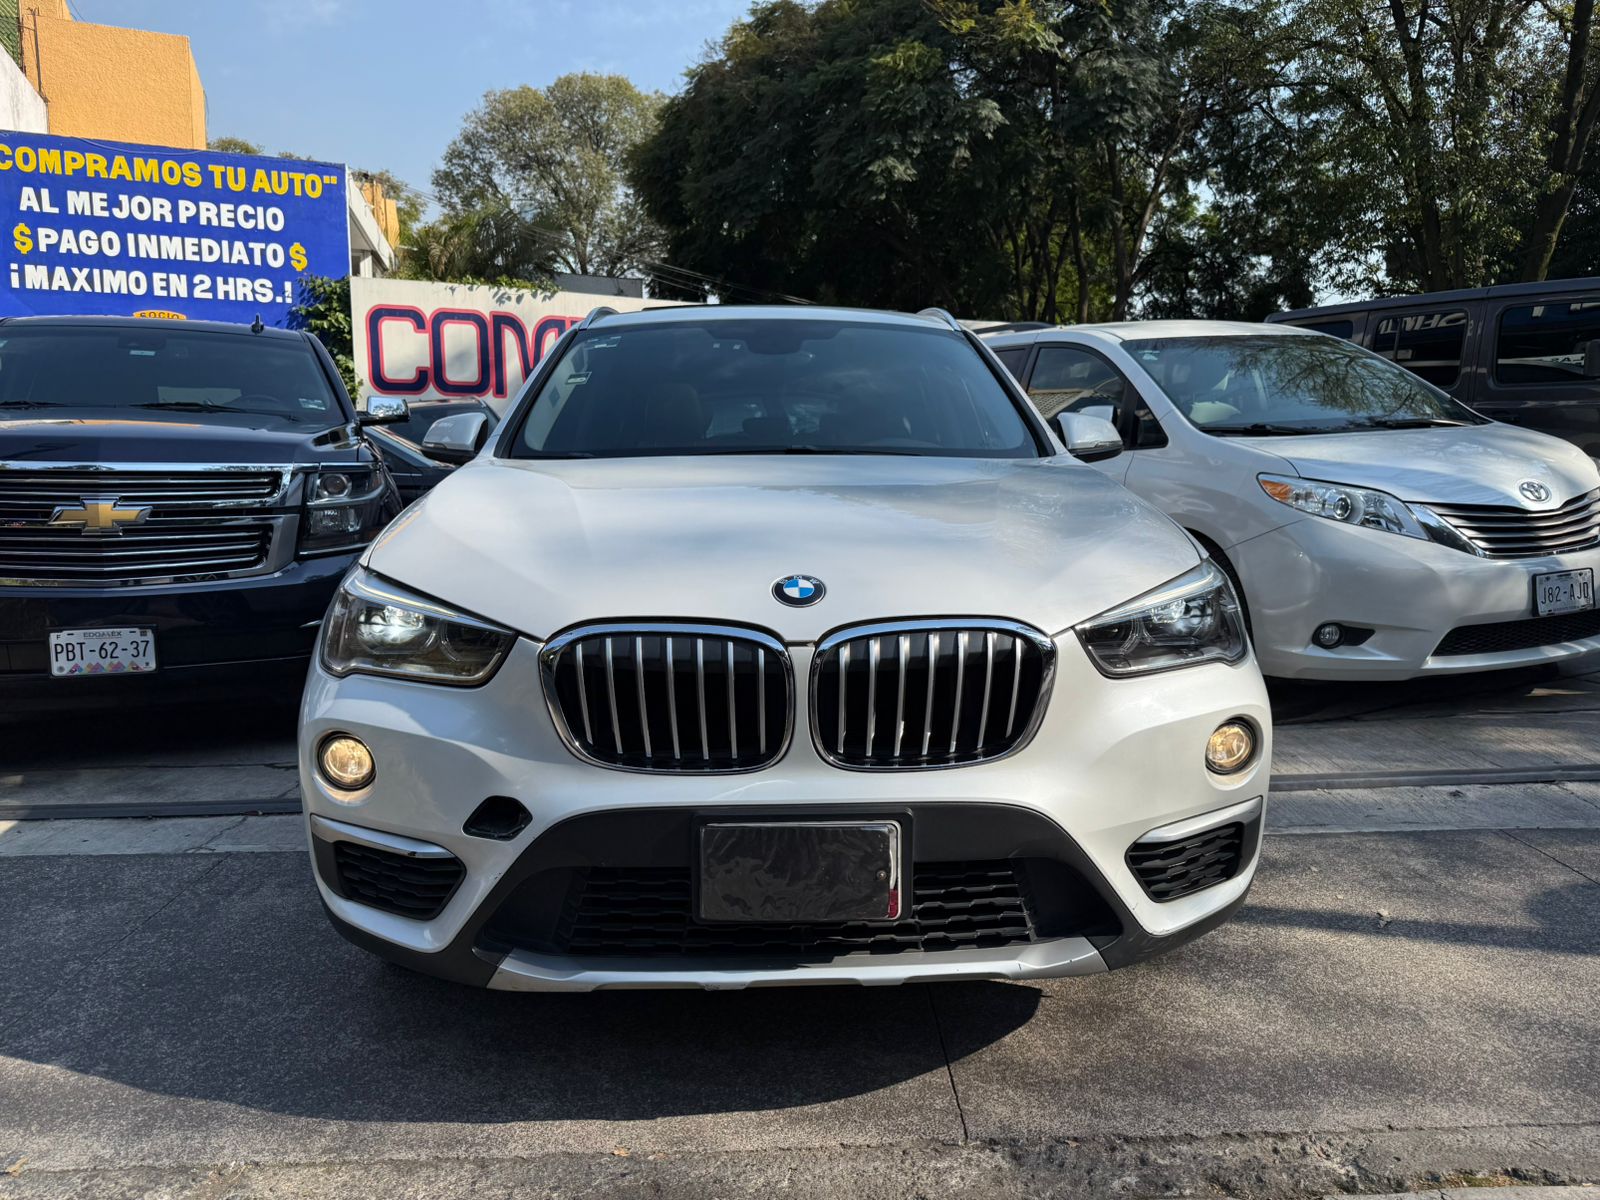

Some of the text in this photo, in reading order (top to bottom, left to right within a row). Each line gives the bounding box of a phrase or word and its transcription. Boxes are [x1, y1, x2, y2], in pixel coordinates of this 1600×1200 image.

[0, 143, 203, 188] COMPRAMOS
[208, 164, 247, 192] TU
[19, 186, 285, 232] AL MEJOR PRECIO
[37, 227, 121, 257] PAGO
[126, 232, 285, 269] INMEDIATO
[152, 272, 189, 299] EN
[192, 274, 213, 300] 2
[54, 640, 150, 663] PBT-62-37
